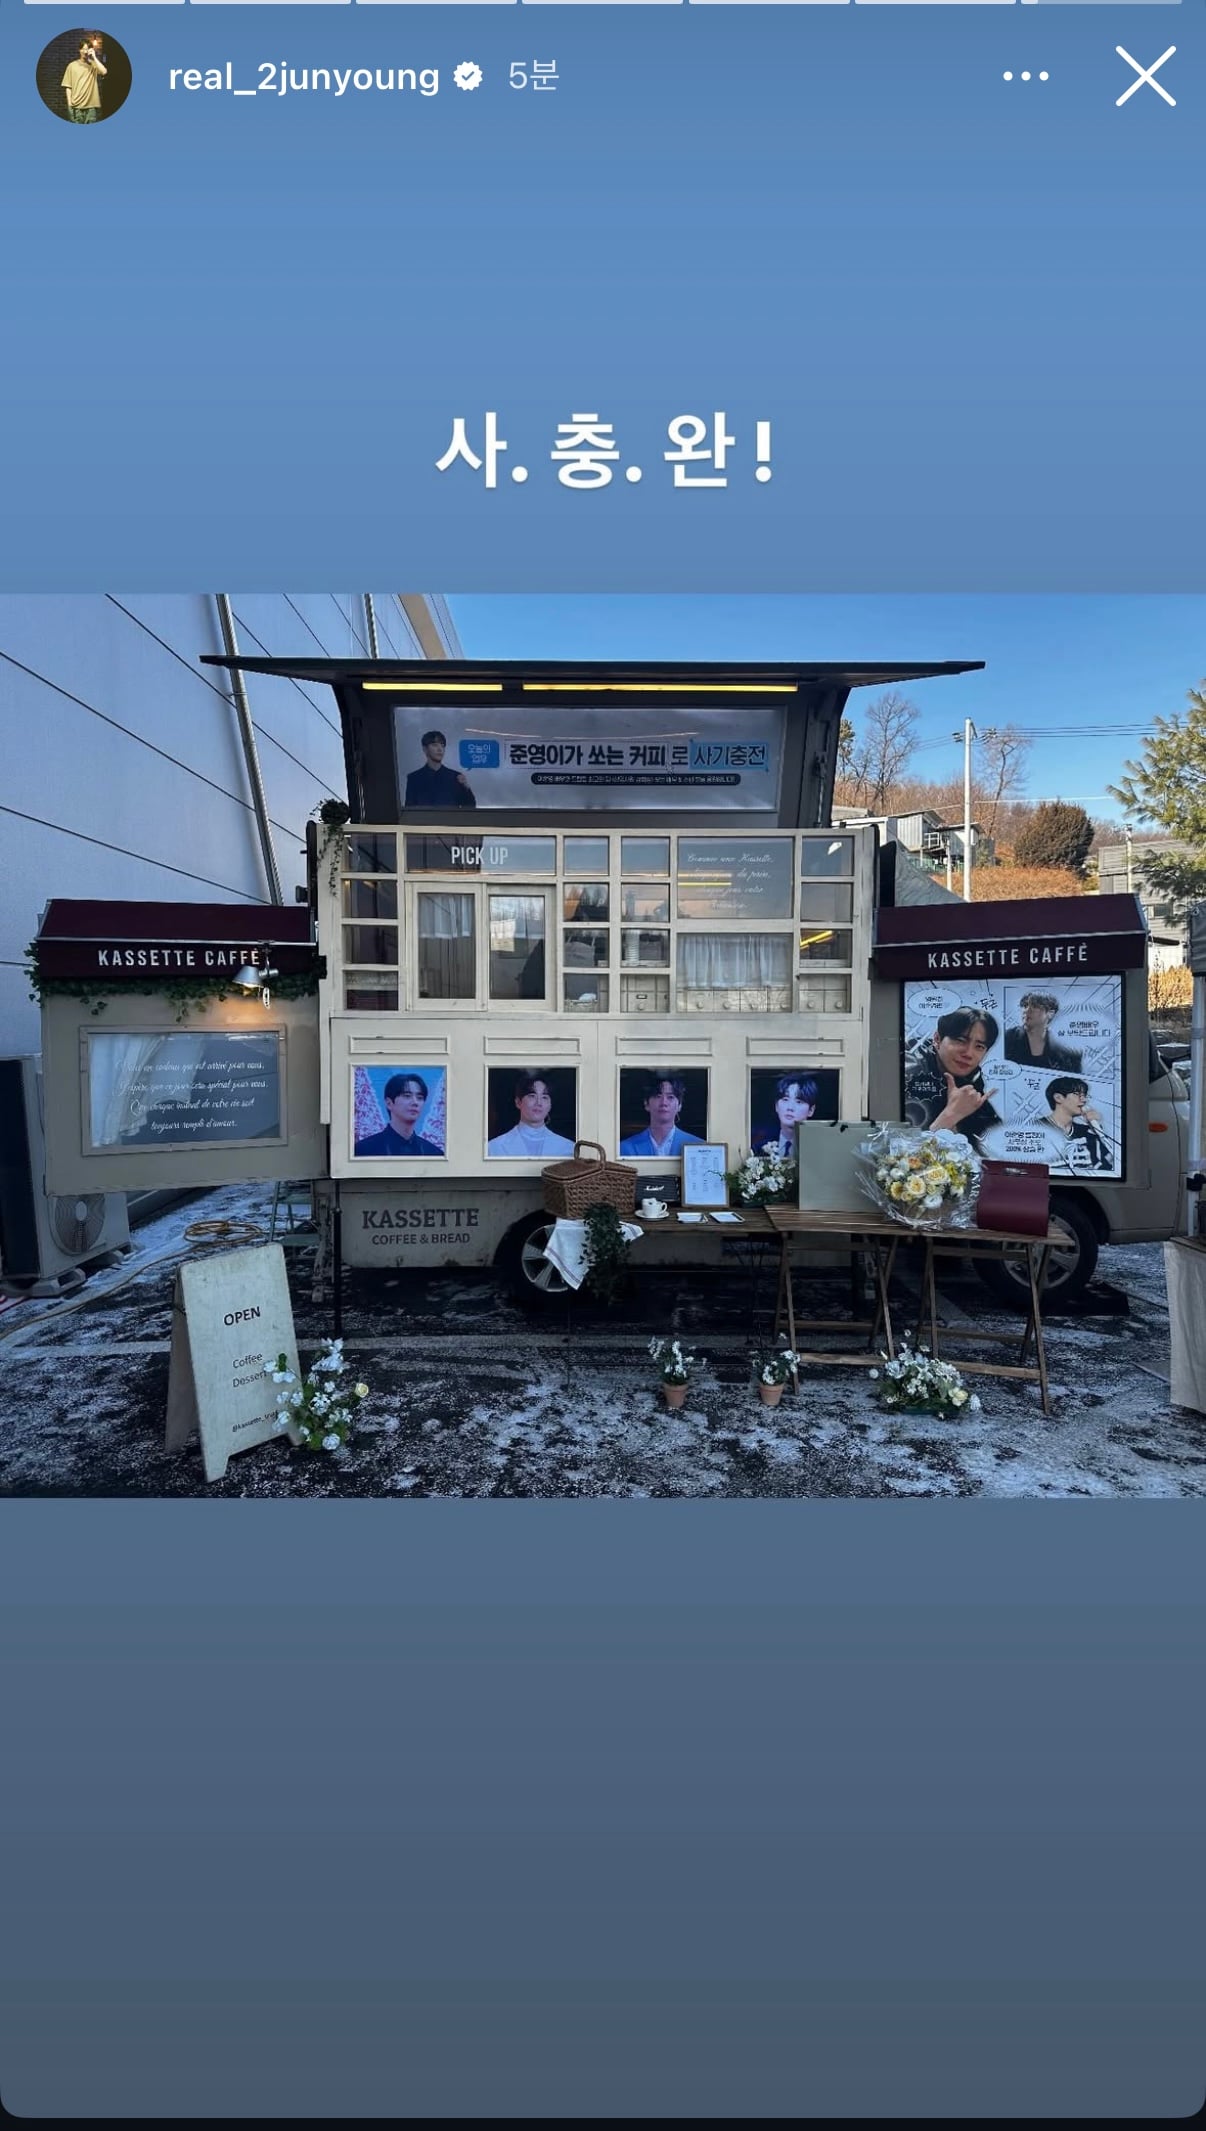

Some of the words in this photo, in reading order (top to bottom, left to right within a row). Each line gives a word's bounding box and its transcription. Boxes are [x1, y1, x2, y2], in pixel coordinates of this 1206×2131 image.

[509, 744, 583, 766] 준영이가
[588, 745, 624, 765] 쏘는
[629, 744, 666, 766] 커피
[693, 745, 766, 766] 사기충전
[451, 847, 486, 866] PICK
[489, 847, 509, 865] UP
[98, 949, 196, 966] KASSETTE
[927, 949, 1020, 968] KASSETTE
[362, 1208, 480, 1229] KASSETTE
[372, 1234, 417, 1246] COFFEE
[420, 1234, 429, 1244] &
[431, 1233, 471, 1244] BREAD
[223, 1306, 261, 1326] OPEN
[232, 1353, 263, 1369] Coffee
